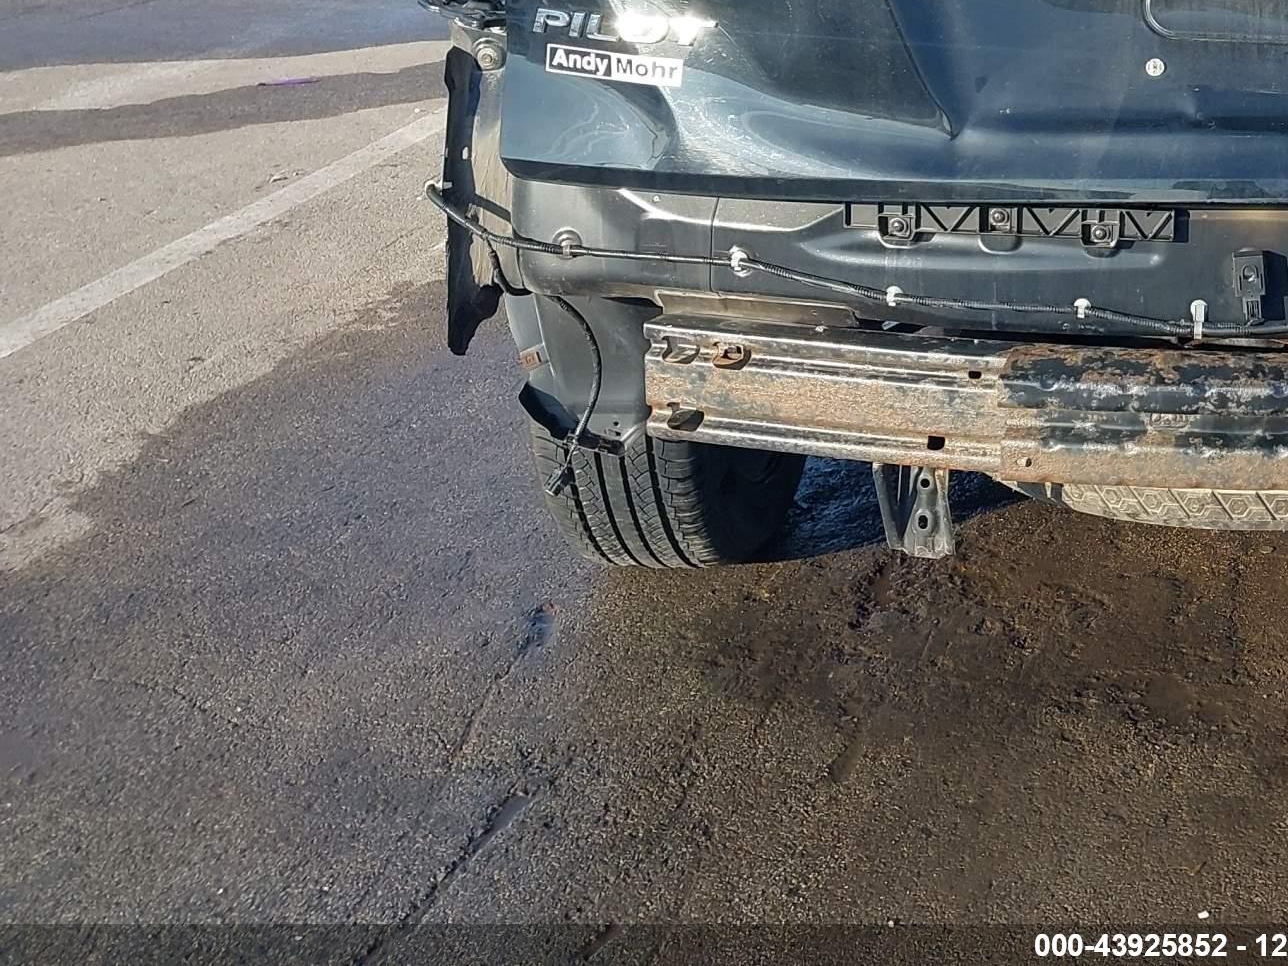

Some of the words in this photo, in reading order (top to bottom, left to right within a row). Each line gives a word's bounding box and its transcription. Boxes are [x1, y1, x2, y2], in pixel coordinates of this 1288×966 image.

[532, 7, 719, 46] PILOT
[551, 48, 610, 76] Andy
[615, 57, 679, 80] Mohr
